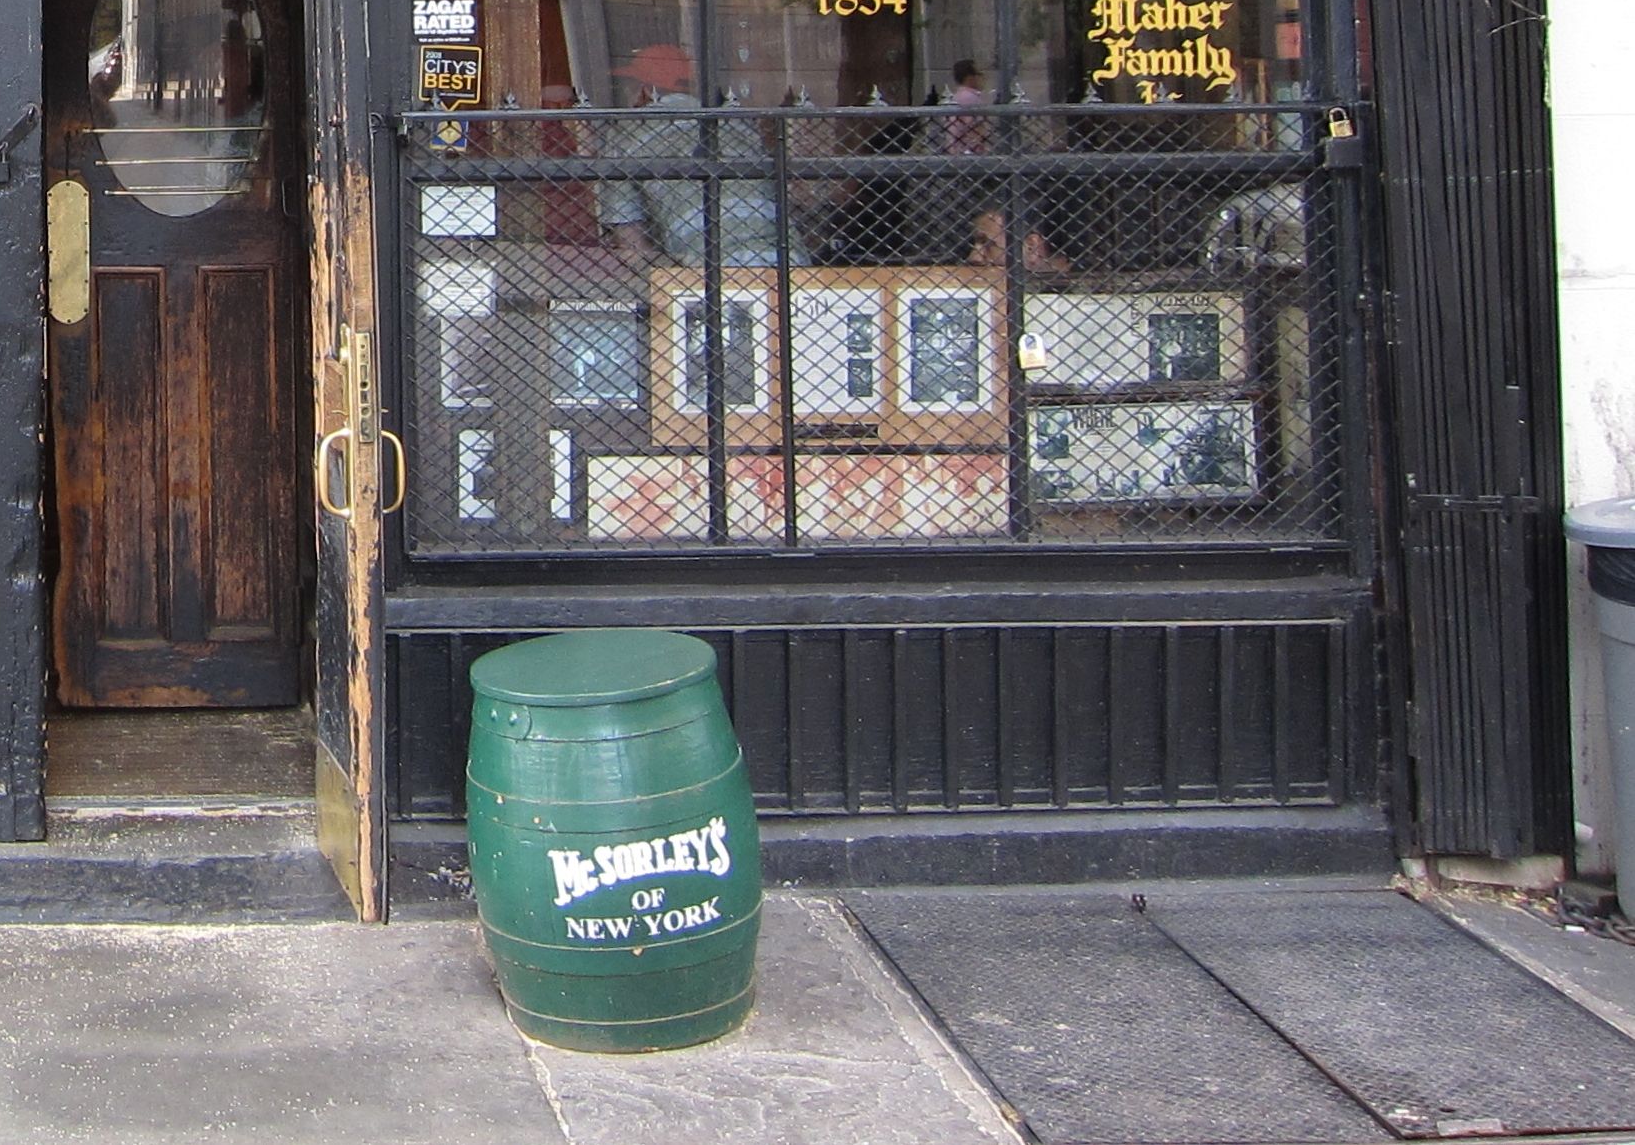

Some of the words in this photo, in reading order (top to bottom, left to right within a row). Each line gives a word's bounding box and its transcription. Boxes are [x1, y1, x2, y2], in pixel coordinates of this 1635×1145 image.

[413, 0, 474, 15] ZAGAT
[413, 15, 475, 30] RATED
[424, 59, 477, 75] CITY'S
[1092, 34, 1237, 92] Family
[424, 73, 476, 90] BEST
[631, 887, 666, 910] OF
[565, 916, 632, 939] NEW
[642, 896, 721, 936] YORK
